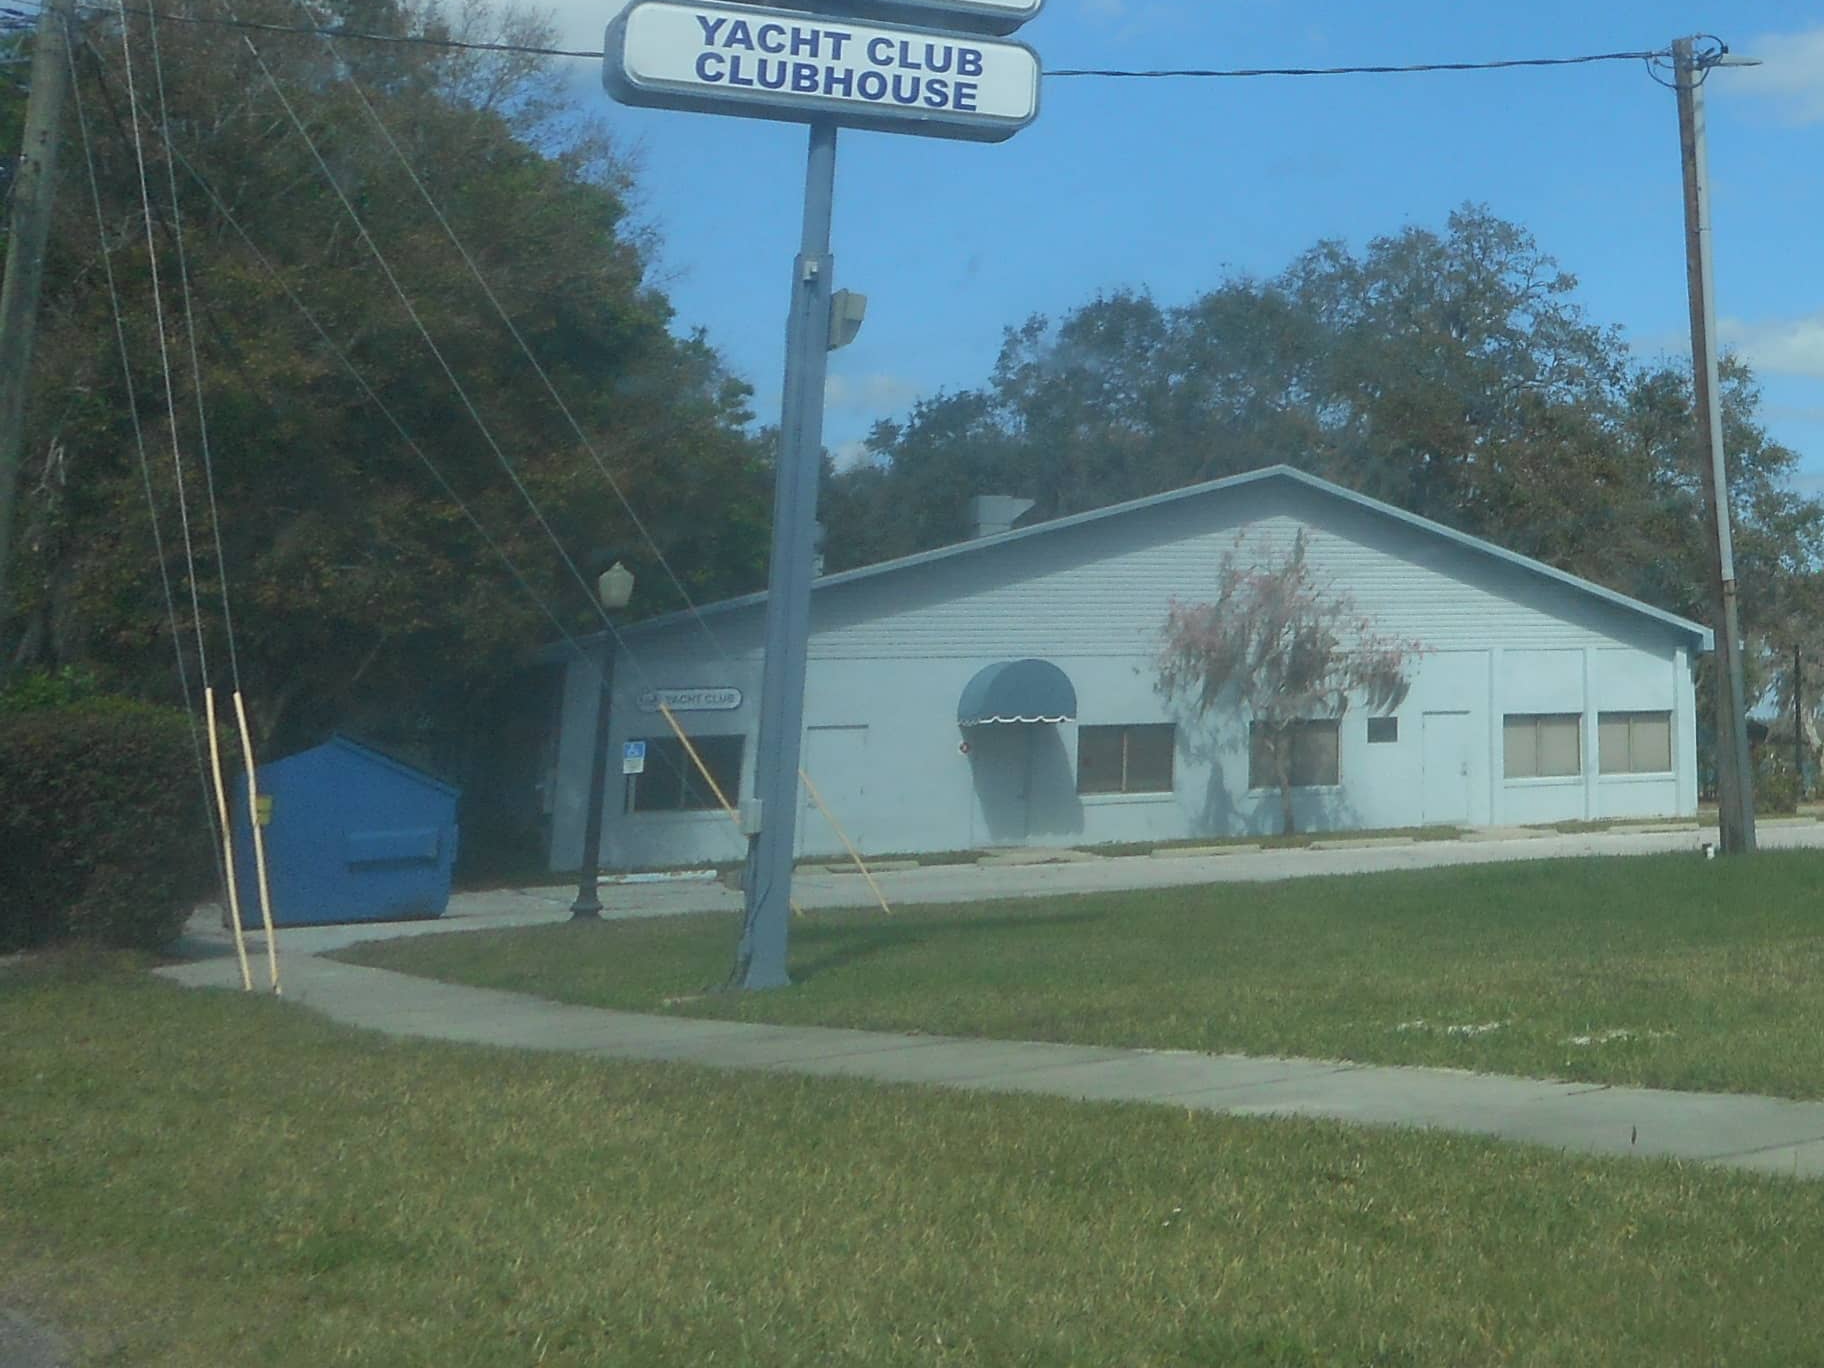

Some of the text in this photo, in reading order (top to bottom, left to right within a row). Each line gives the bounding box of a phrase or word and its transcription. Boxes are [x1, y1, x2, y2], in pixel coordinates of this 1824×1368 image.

[695, 14, 984, 77] YACHT CLUB
[694, 52, 979, 112] CLUBHOUSE
